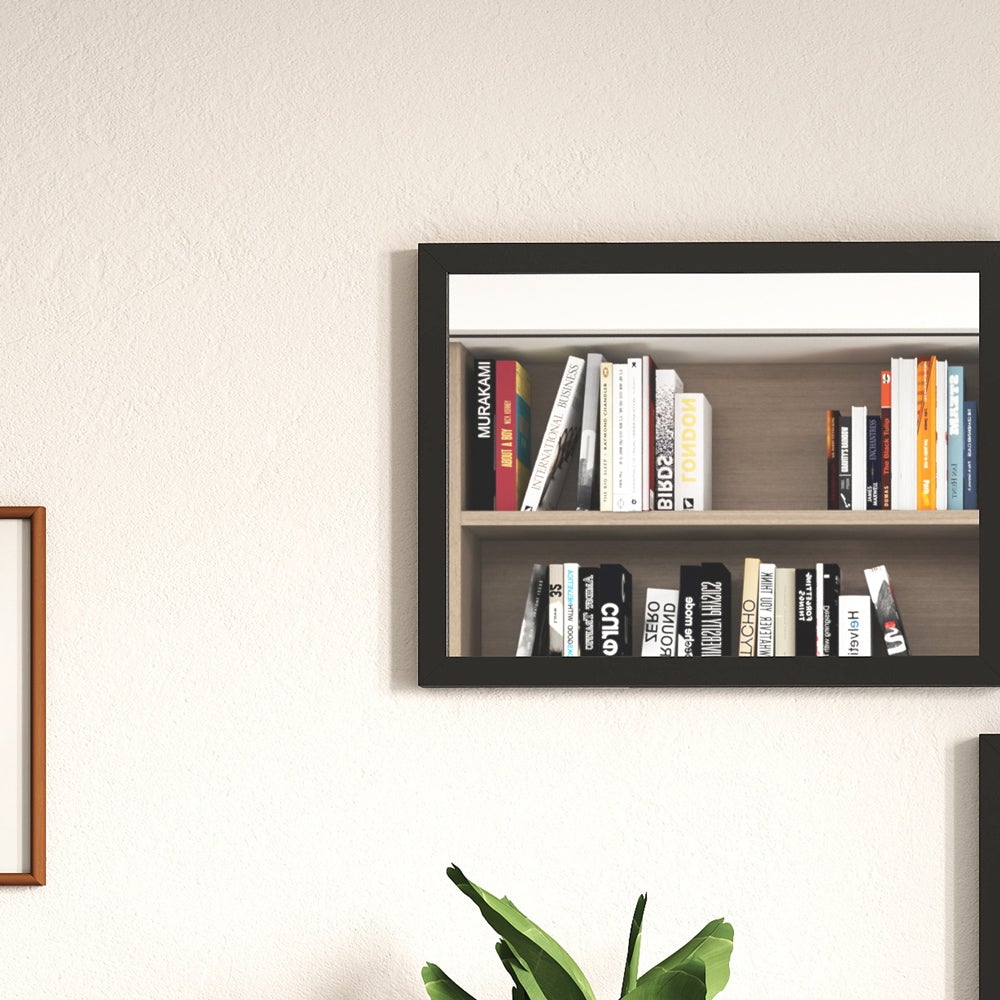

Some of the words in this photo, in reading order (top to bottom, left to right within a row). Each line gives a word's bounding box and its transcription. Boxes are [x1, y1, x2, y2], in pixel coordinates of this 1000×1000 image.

[477, 361, 491, 439] MURAKAMI
[501, 428, 512, 440] BOY
[531, 413, 565, 492] INTERNATIONAL
[558, 363, 580, 409] BUSINESS
[501, 449, 512, 467] ABOUT
